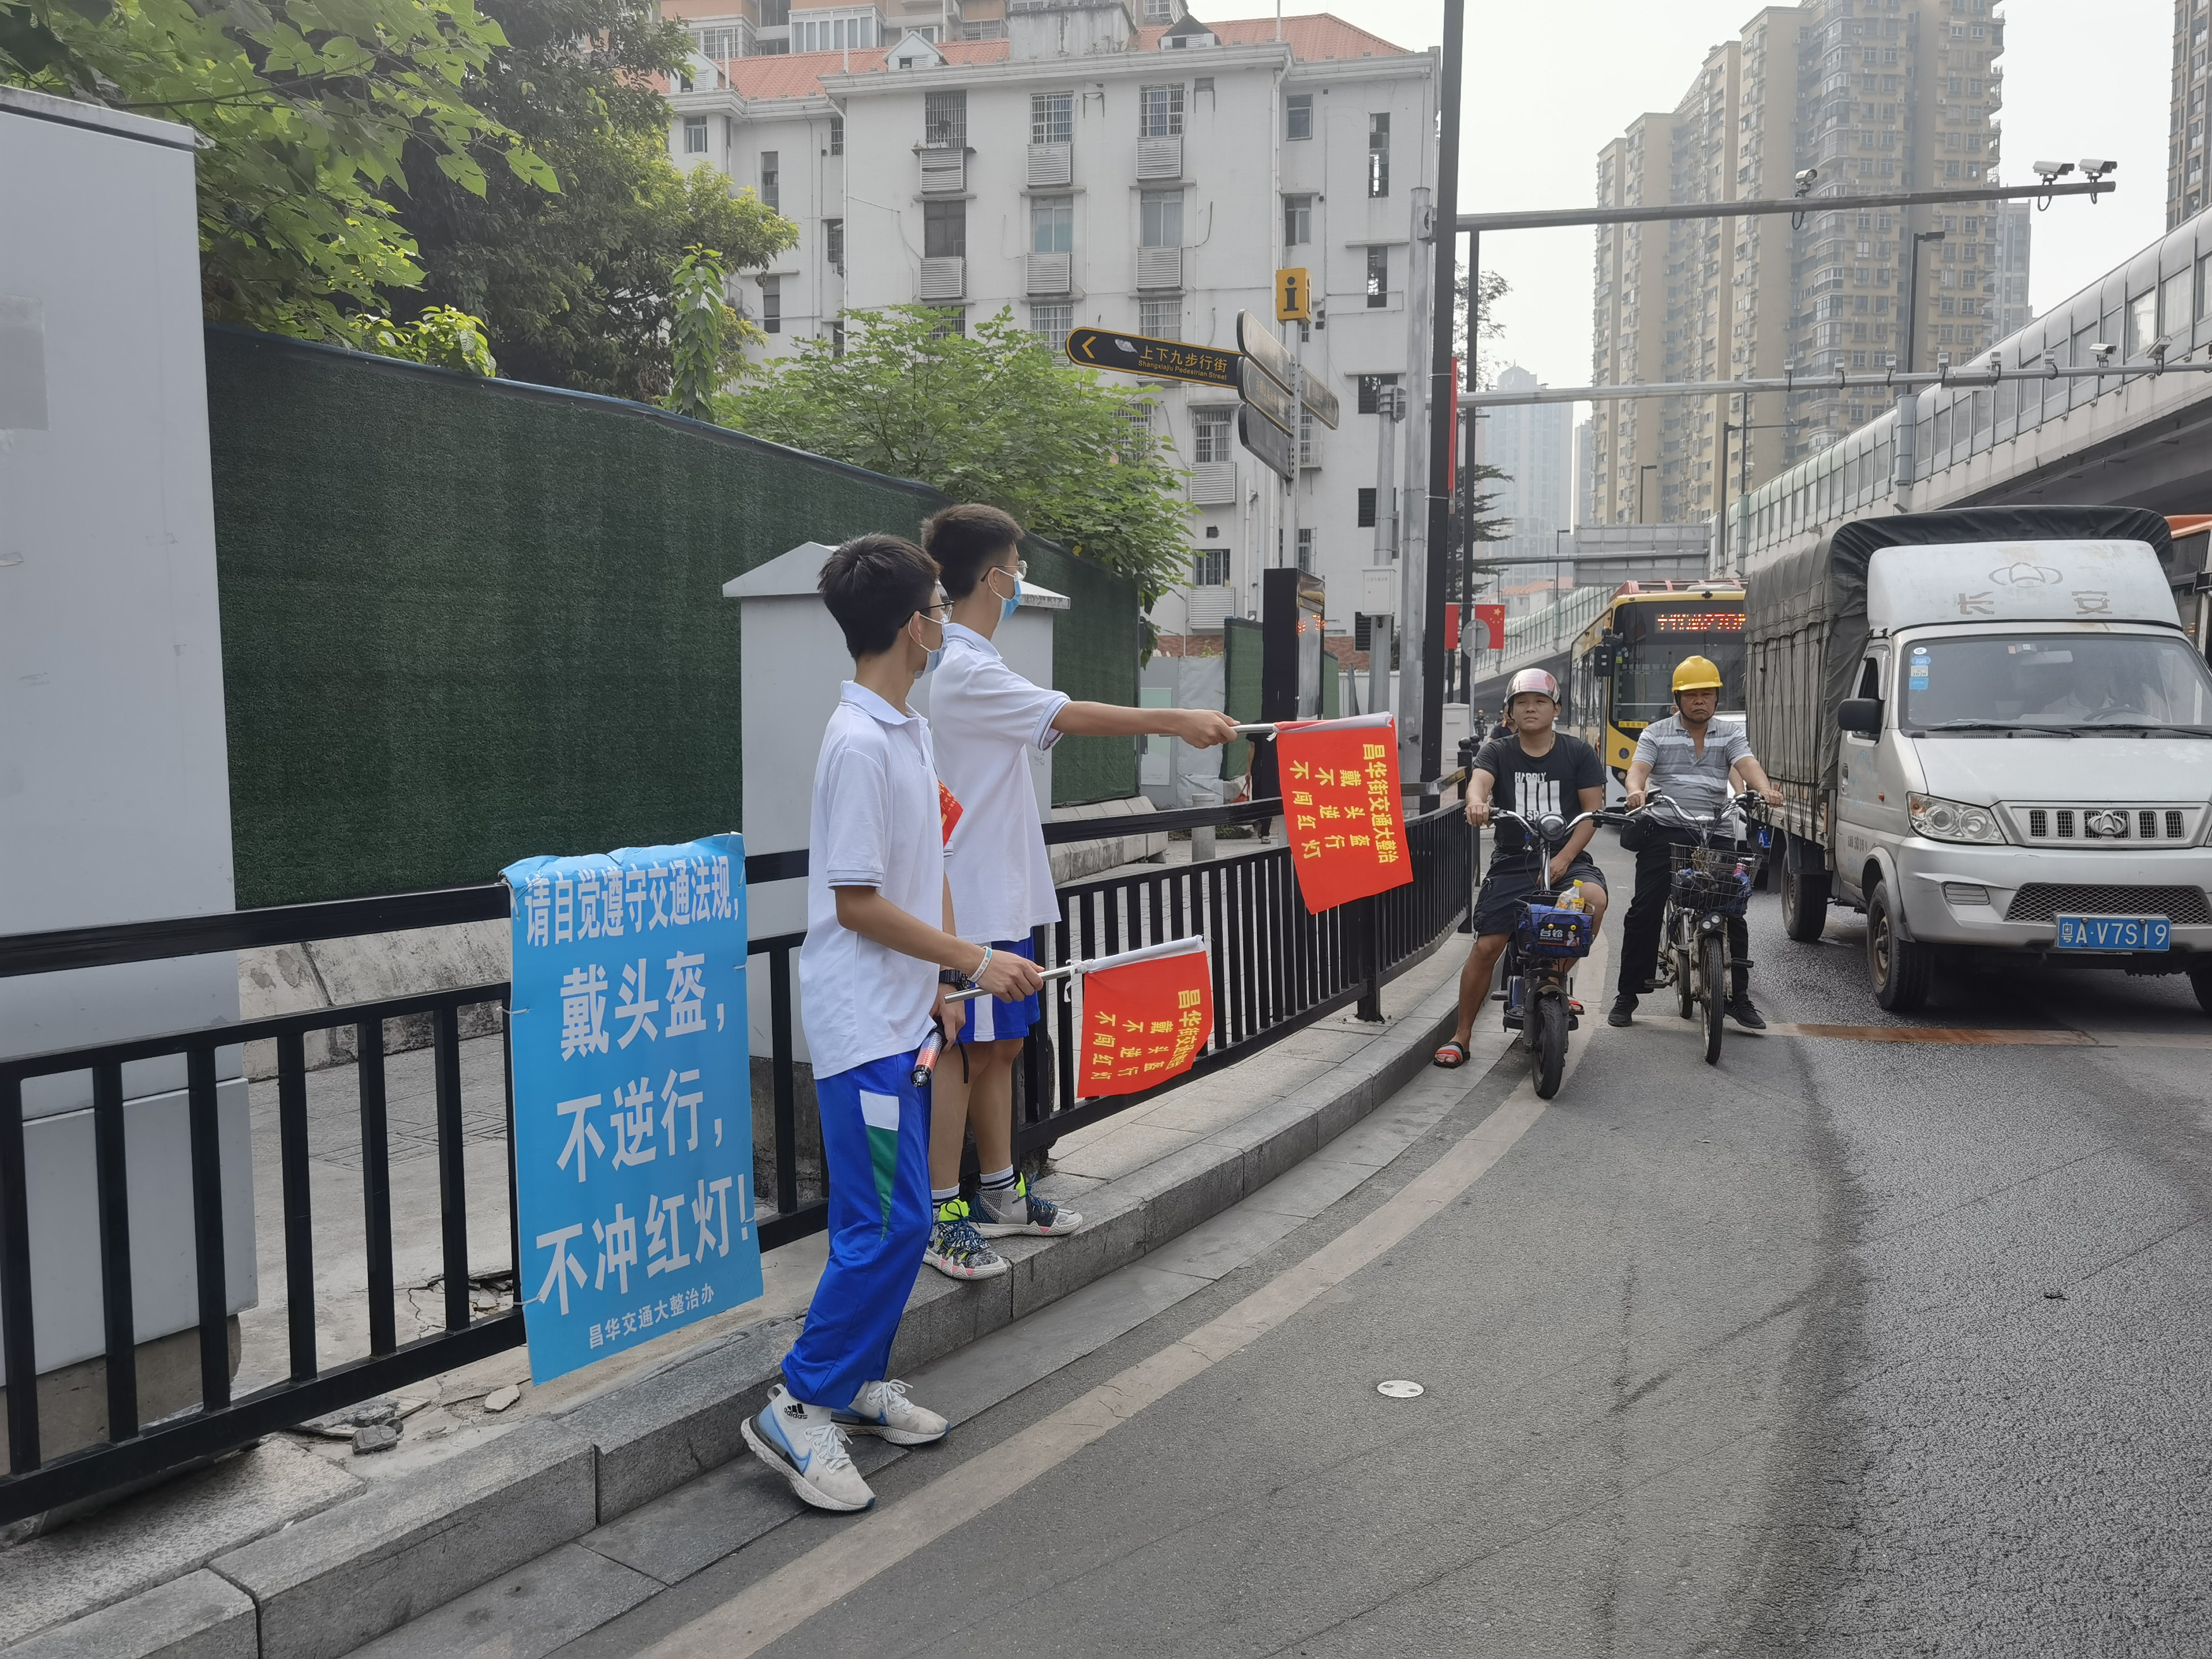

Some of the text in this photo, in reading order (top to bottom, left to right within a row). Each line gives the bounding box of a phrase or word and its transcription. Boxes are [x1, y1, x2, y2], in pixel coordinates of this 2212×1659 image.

[1138, 360, 1227, 381] Shangxiajiu Pedestrian Street
[1140, 345, 1228, 373] 上下九步行街
[1958, 590, 2113, 615] 长安
[1289, 759, 1321, 859] 不闯红灯
[1314, 767, 1345, 849] 不逆行
[1339, 770, 1370, 847] 戴头盔
[1363, 744, 1399, 864] 昌华街交通大整治
[524, 854, 739, 947] 请自觉遵守交通法规，
[1540, 928, 1563, 938] 台铃
[559, 950, 725, 1062] 戴头盔，
[1091, 1010, 1116, 1080] 不闯红灯
[1117, 1020, 1144, 1077] 不逆行
[556, 1069, 723, 1183] 不逆行，
[536, 1174, 750, 1316] 不冲红灯！
[589, 1283, 714, 1349] 昌华交通大整治办
[784, 1407, 808, 1419] adidas
